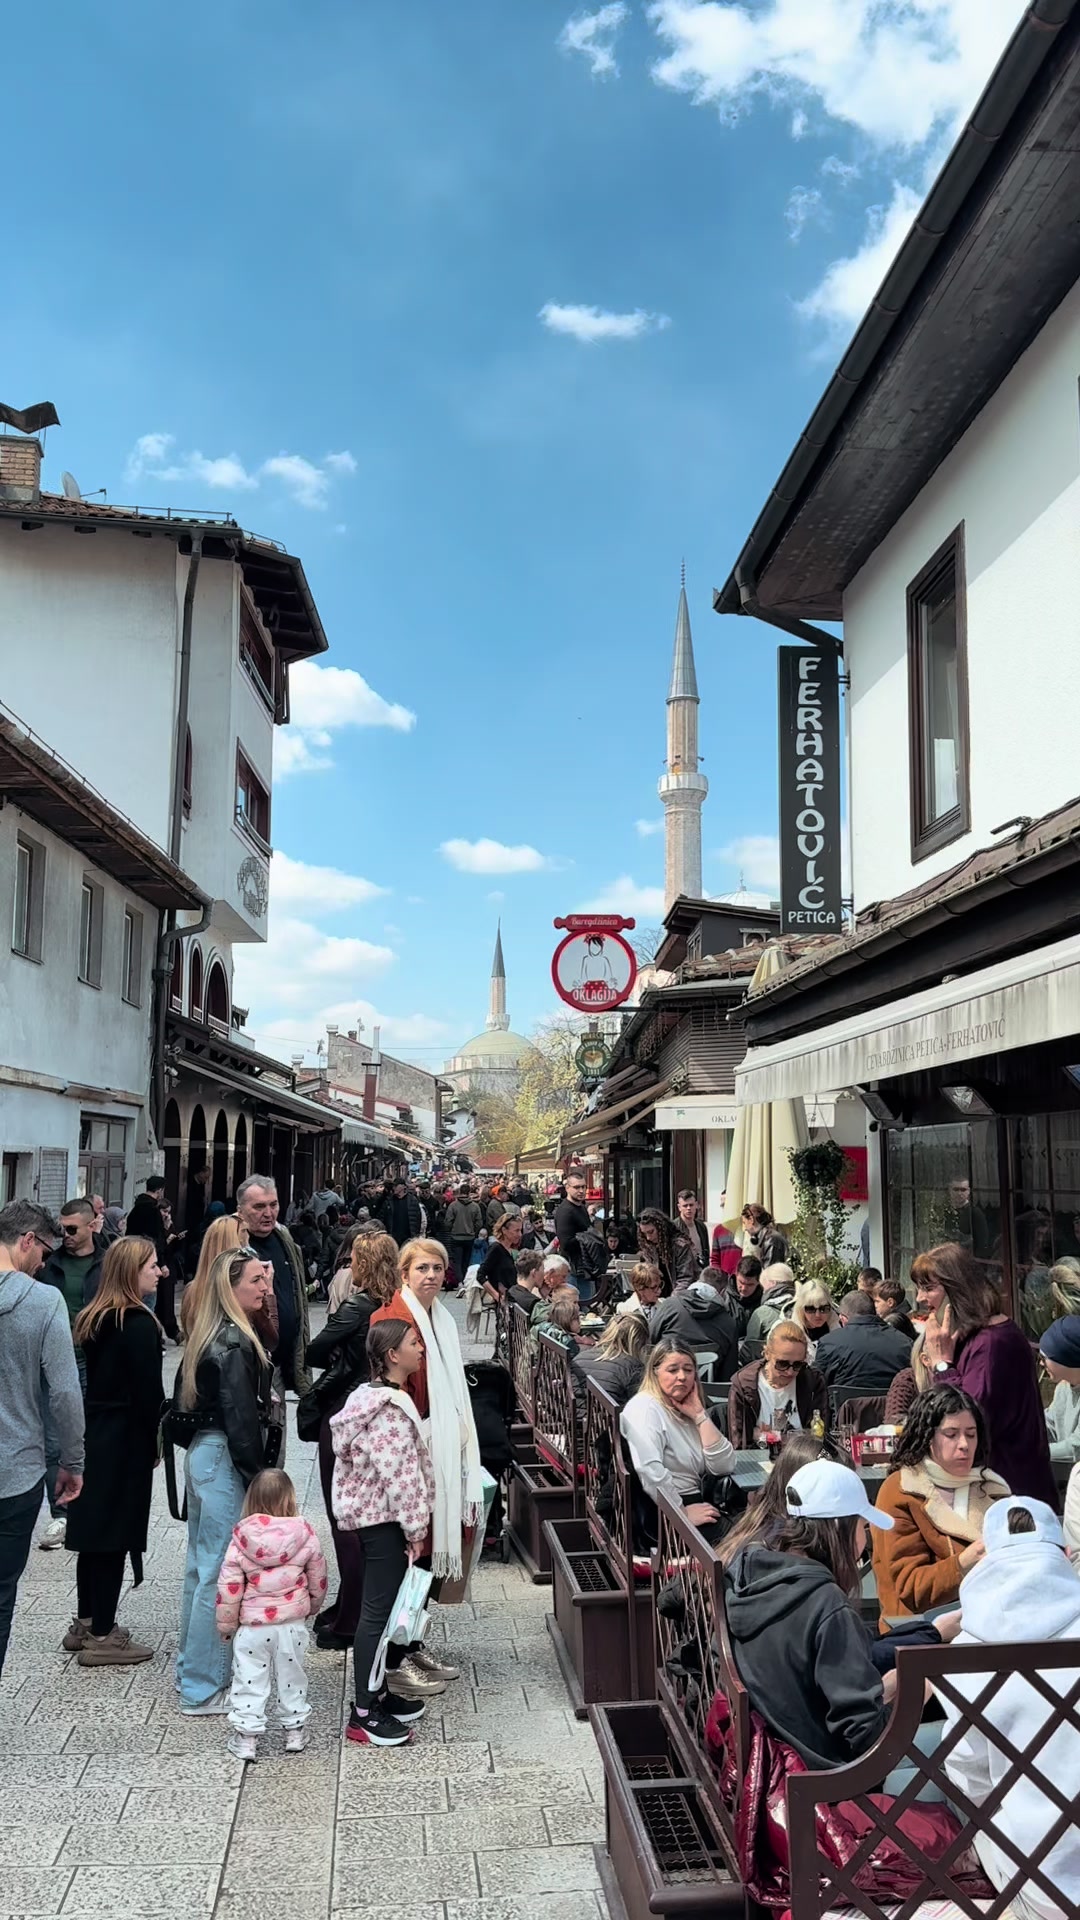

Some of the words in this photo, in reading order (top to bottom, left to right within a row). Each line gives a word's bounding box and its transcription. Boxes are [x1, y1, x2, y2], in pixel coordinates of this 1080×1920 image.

[796, 657, 825, 909] FERHATOVIĆ
[788, 911, 836, 924] PETICA
[572, 988, 617, 1001] OKLAGIJA
